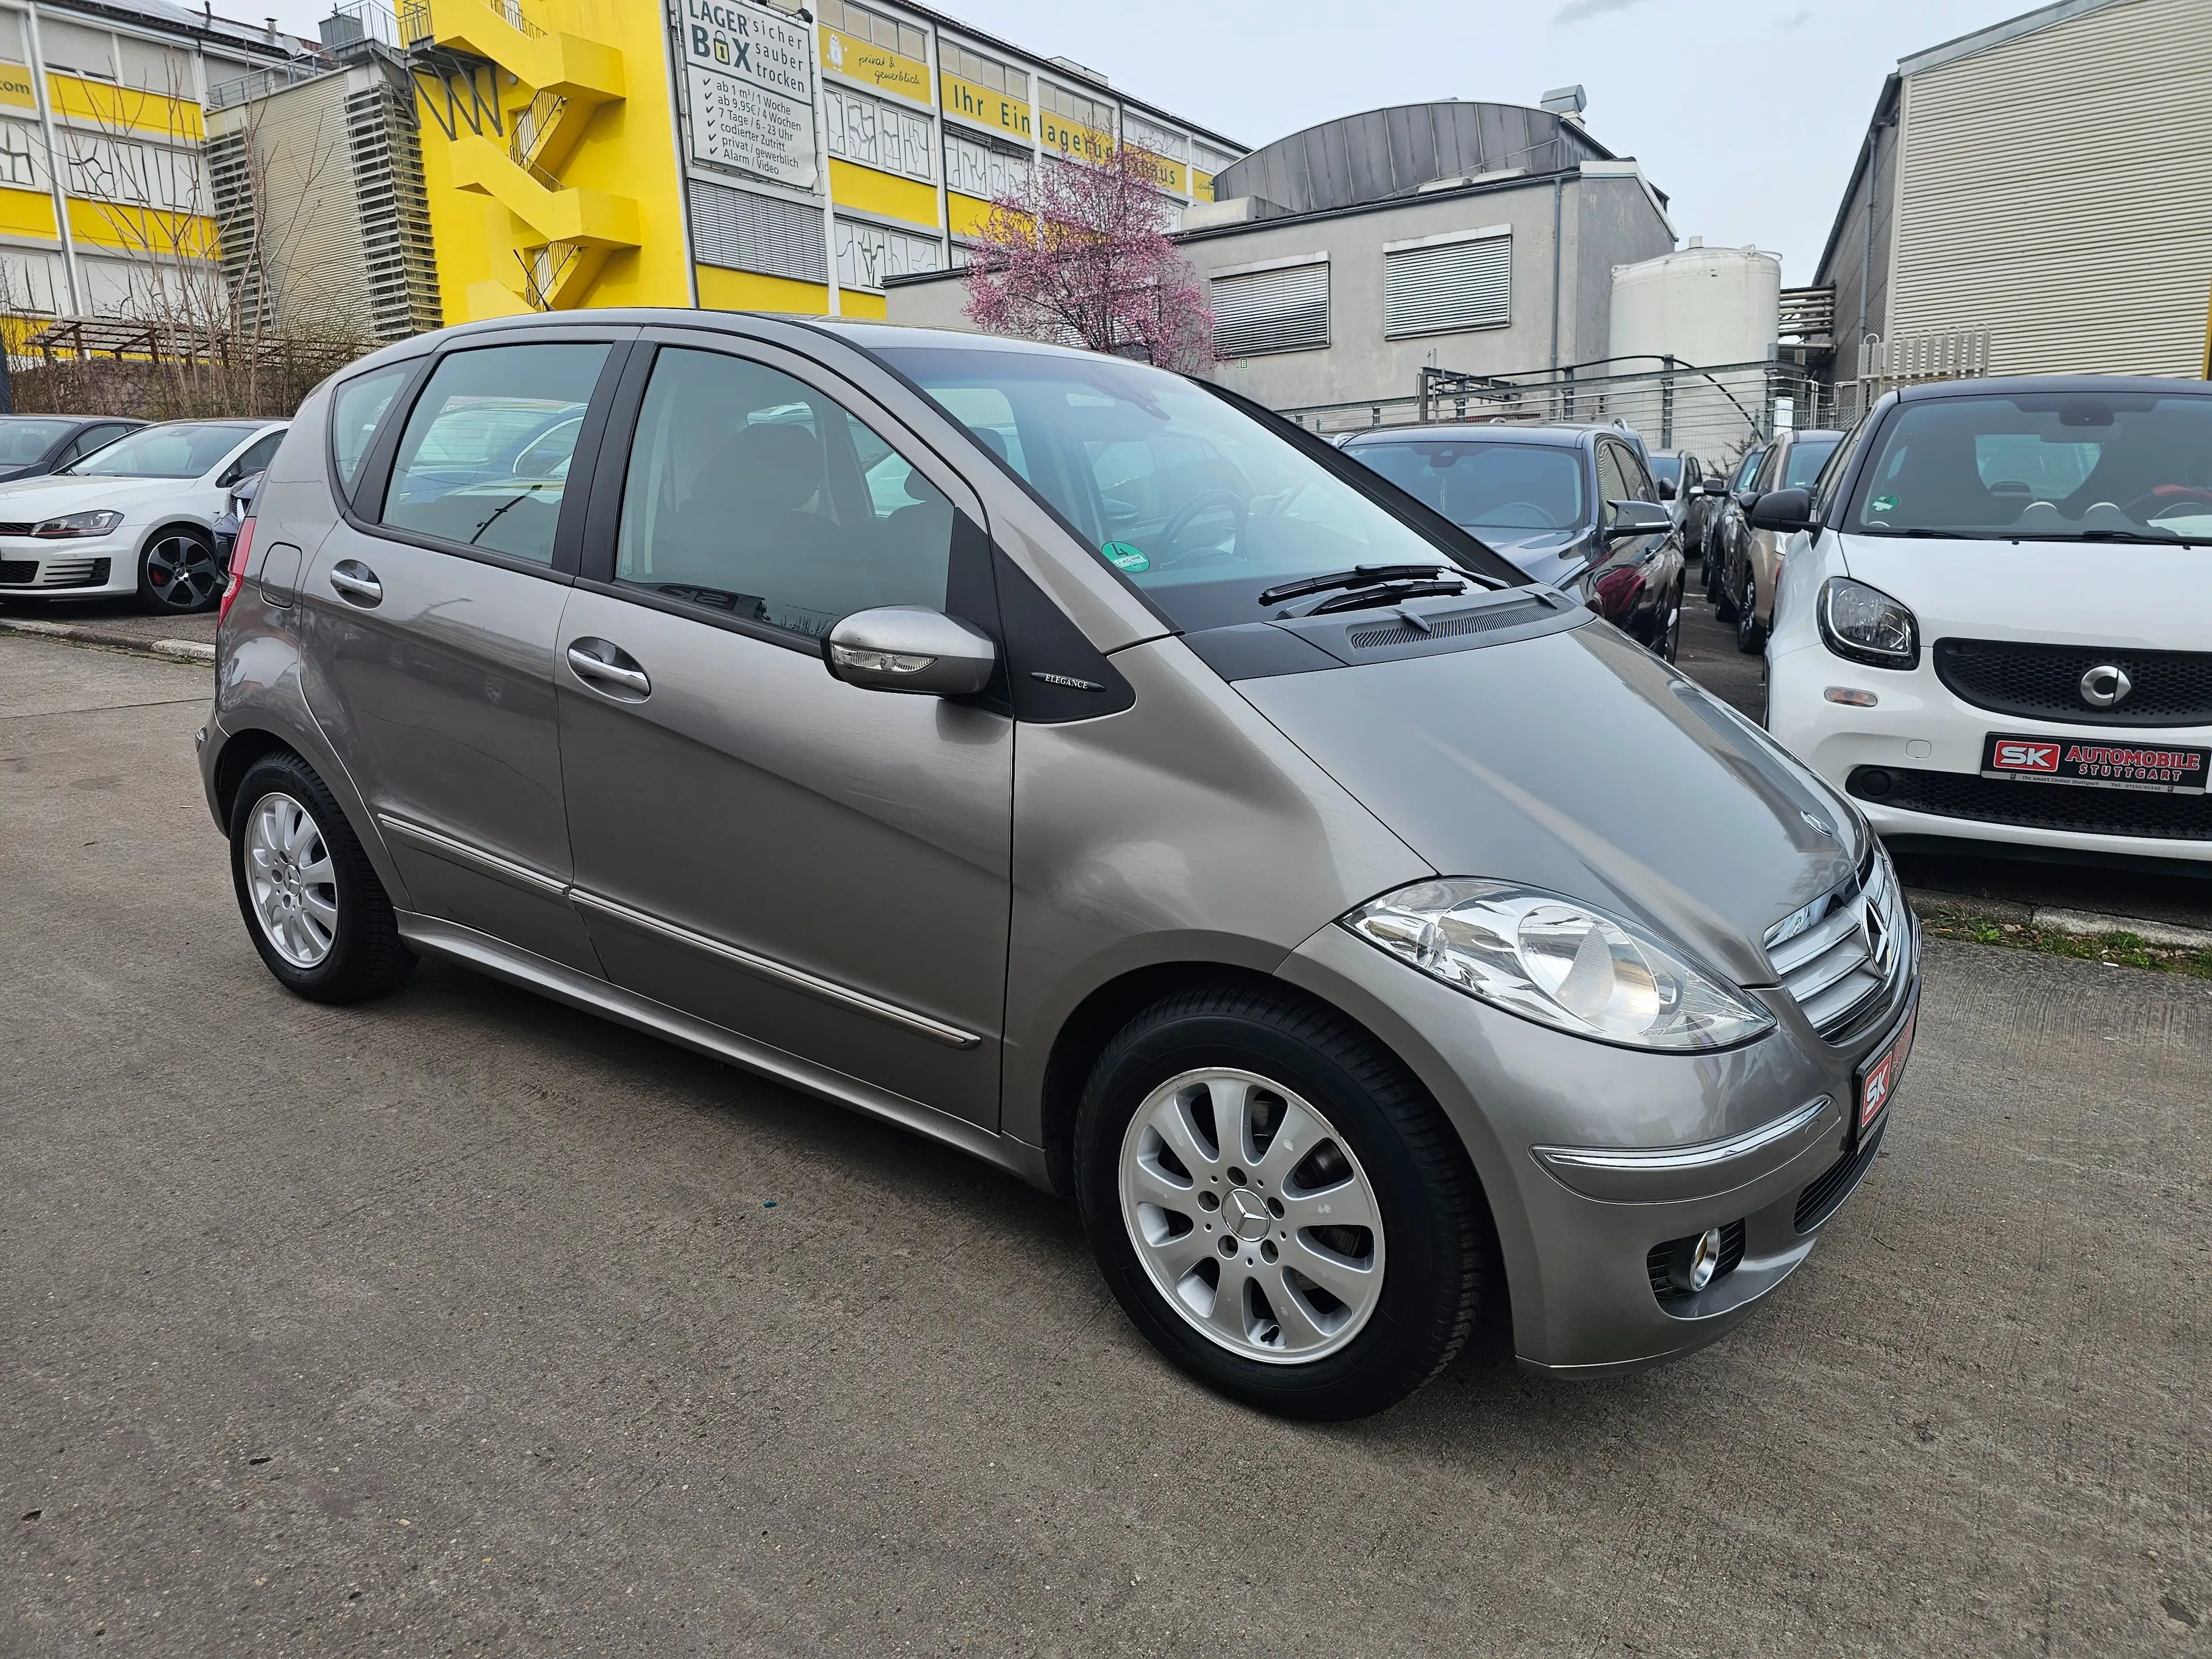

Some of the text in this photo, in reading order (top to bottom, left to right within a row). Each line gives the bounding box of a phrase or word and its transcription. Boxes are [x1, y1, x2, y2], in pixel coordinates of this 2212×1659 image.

[690, 0, 749, 37] LAGER
[753, 20, 802, 50] sicher
[756, 43, 803, 71] sauber
[859, 55, 885, 67] privat
[756, 62, 805, 93] trocken
[874, 70, 921, 85] gewerblich
[717, 81, 728, 92] ab
[732, 85, 736, 95] 1
[757, 94, 761, 104] 1
[763, 96, 791, 115] Woche
[718, 94, 730, 106] ab
[733, 99, 756, 115] 9,95€
[763, 109, 767, 119] 4
[769, 111, 801, 131] Wochen
[953, 84, 983, 116] Ihr
[719, 107, 724, 118] 7
[728, 109, 748, 126] Tage
[756, 119, 760, 130] 6
[767, 124, 776, 135] 23
[778, 128, 793, 142] Uhr
[721, 123, 785, 152] codierter Zutritt
[722, 137, 749, 152] privat
[756, 147, 799, 168] gewerblich
[724, 149, 749, 165] Alarm
[756, 158, 779, 175] Video
[1111, 543, 1129, 556] 4
[1046, 675, 1088, 689] ELEGANCE
[2000, 745, 2200, 770] SK AUTOMOBILE
[2079, 764, 2182, 781] STUTTGART
[1865, 1063, 1889, 1116] SK
